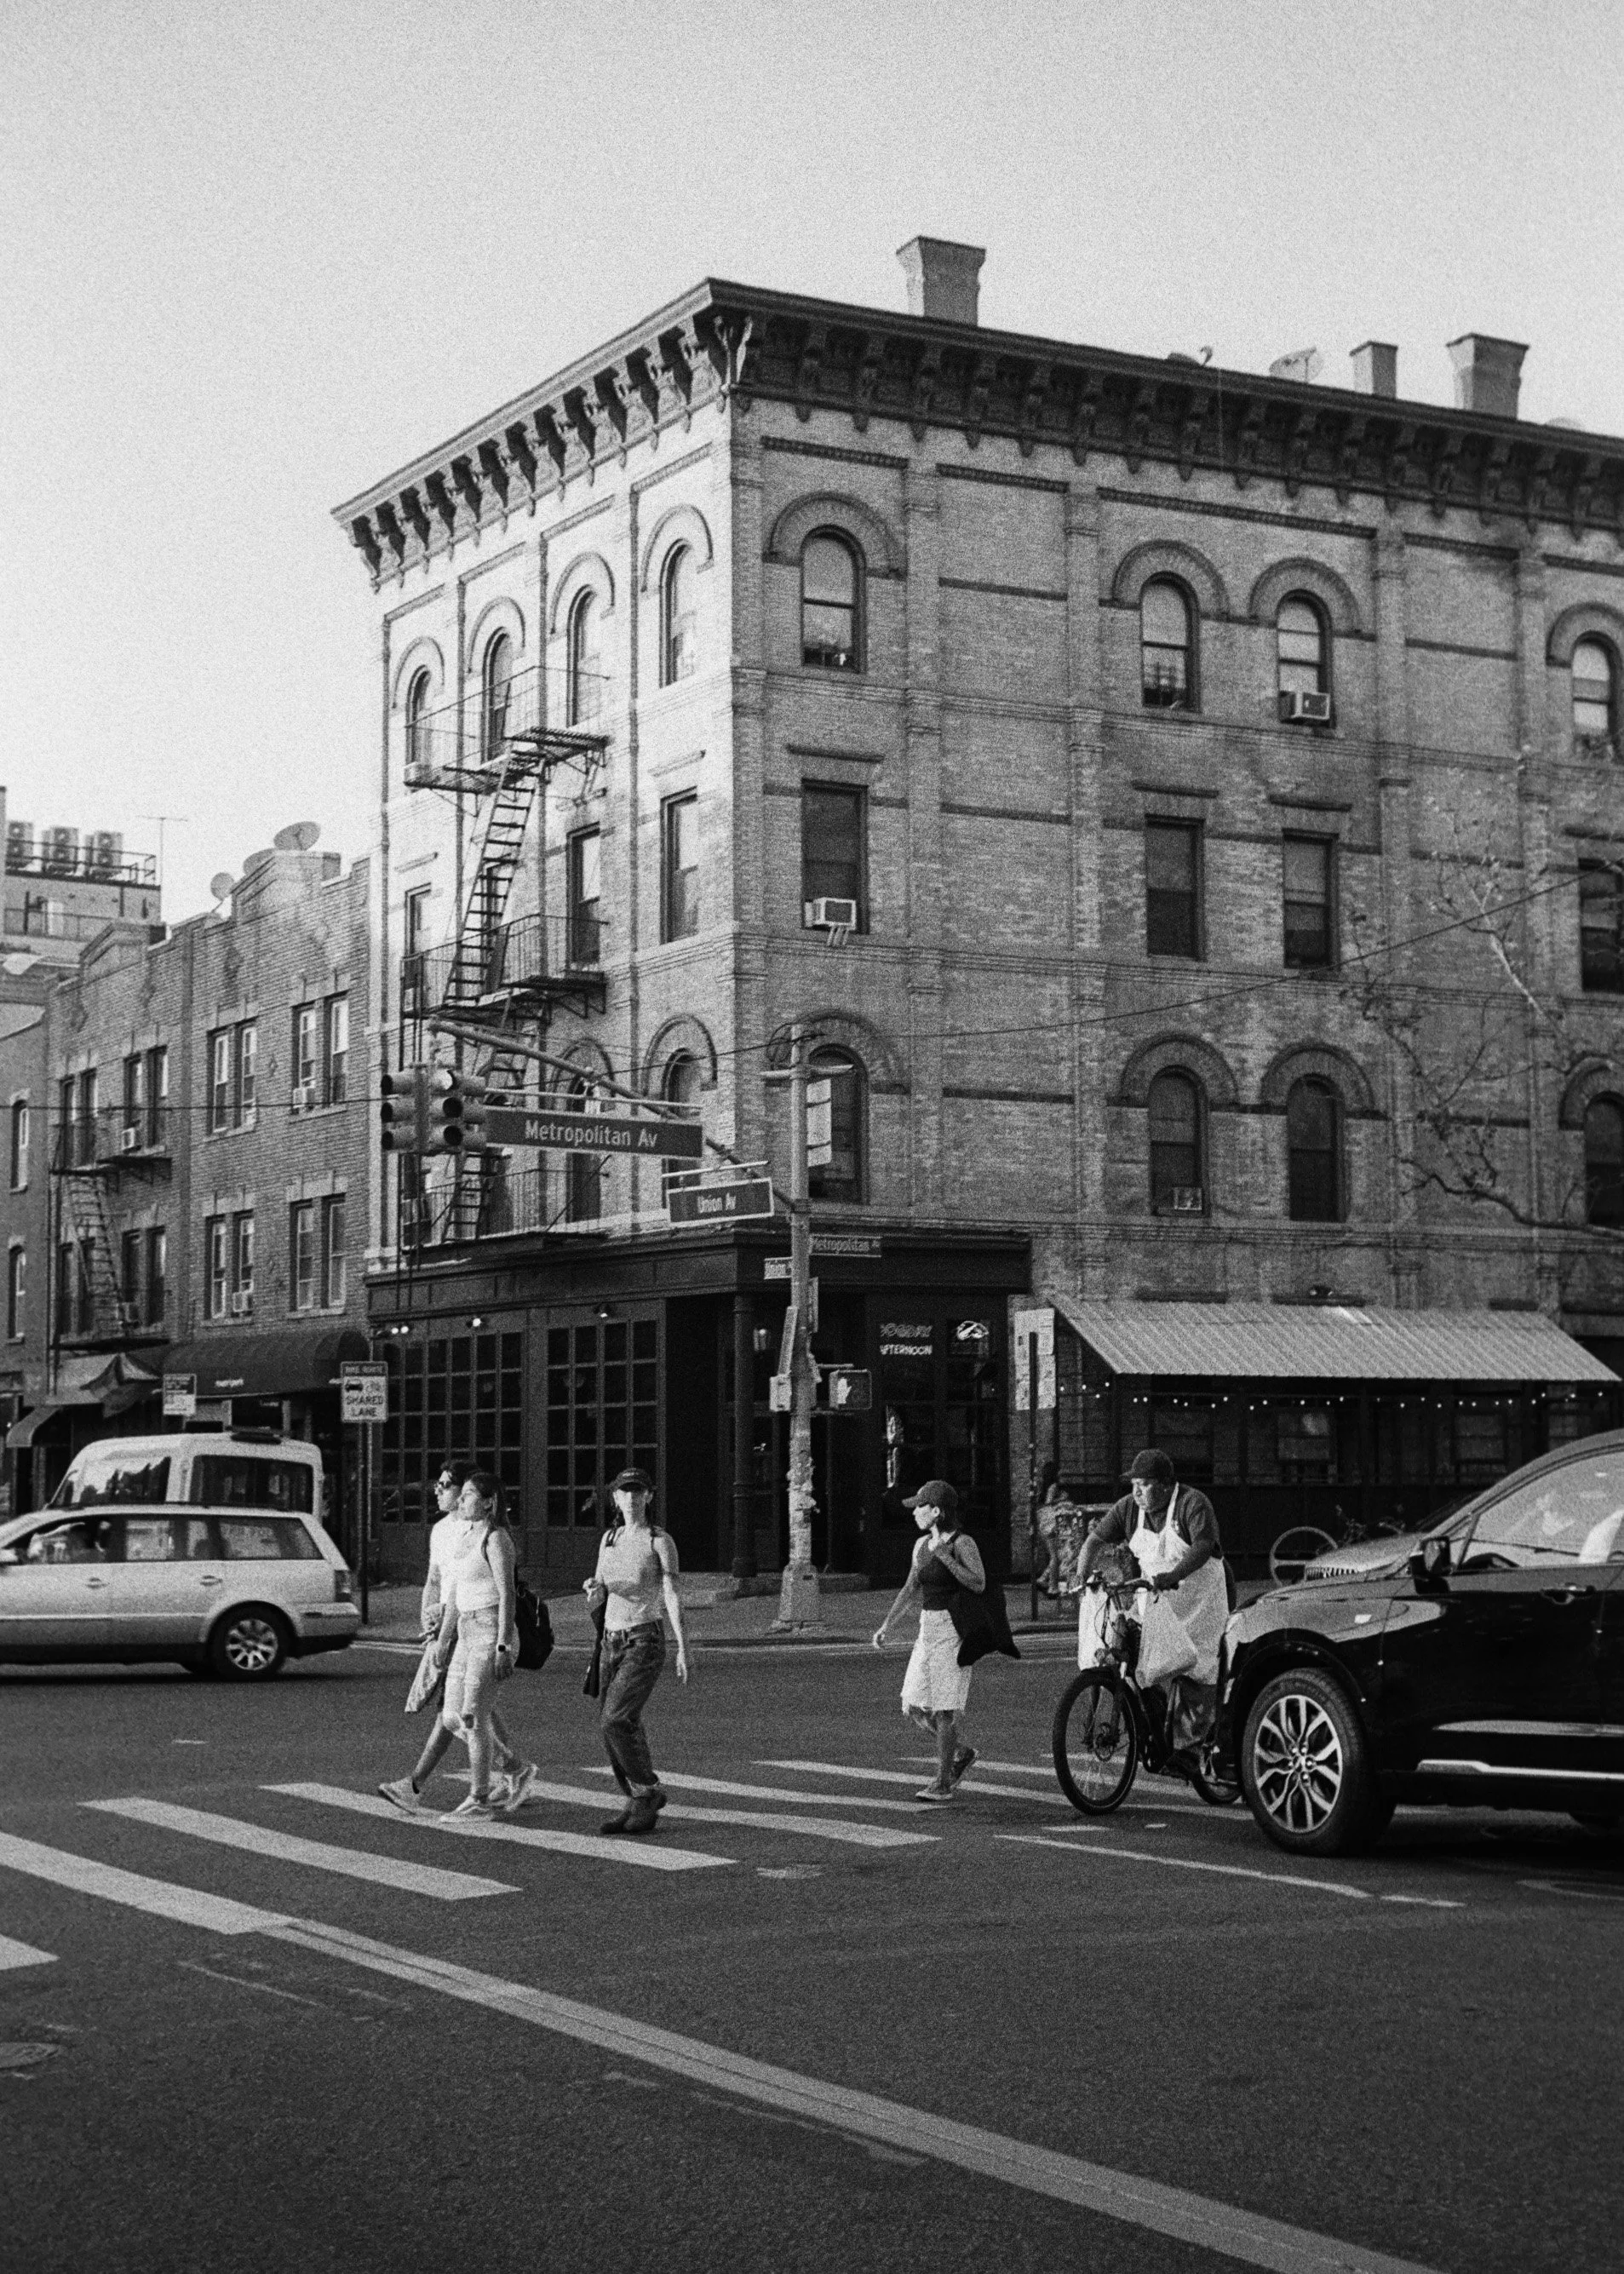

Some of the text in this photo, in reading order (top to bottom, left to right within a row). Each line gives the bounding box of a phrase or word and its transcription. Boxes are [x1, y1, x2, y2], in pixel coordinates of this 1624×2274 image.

[525, 1120, 657, 1147] Metropolitan Av
[697, 1192, 737, 1214] Union Av
[346, 1395, 383, 1405] SHARED
[351, 1407, 376, 1417] LANE
